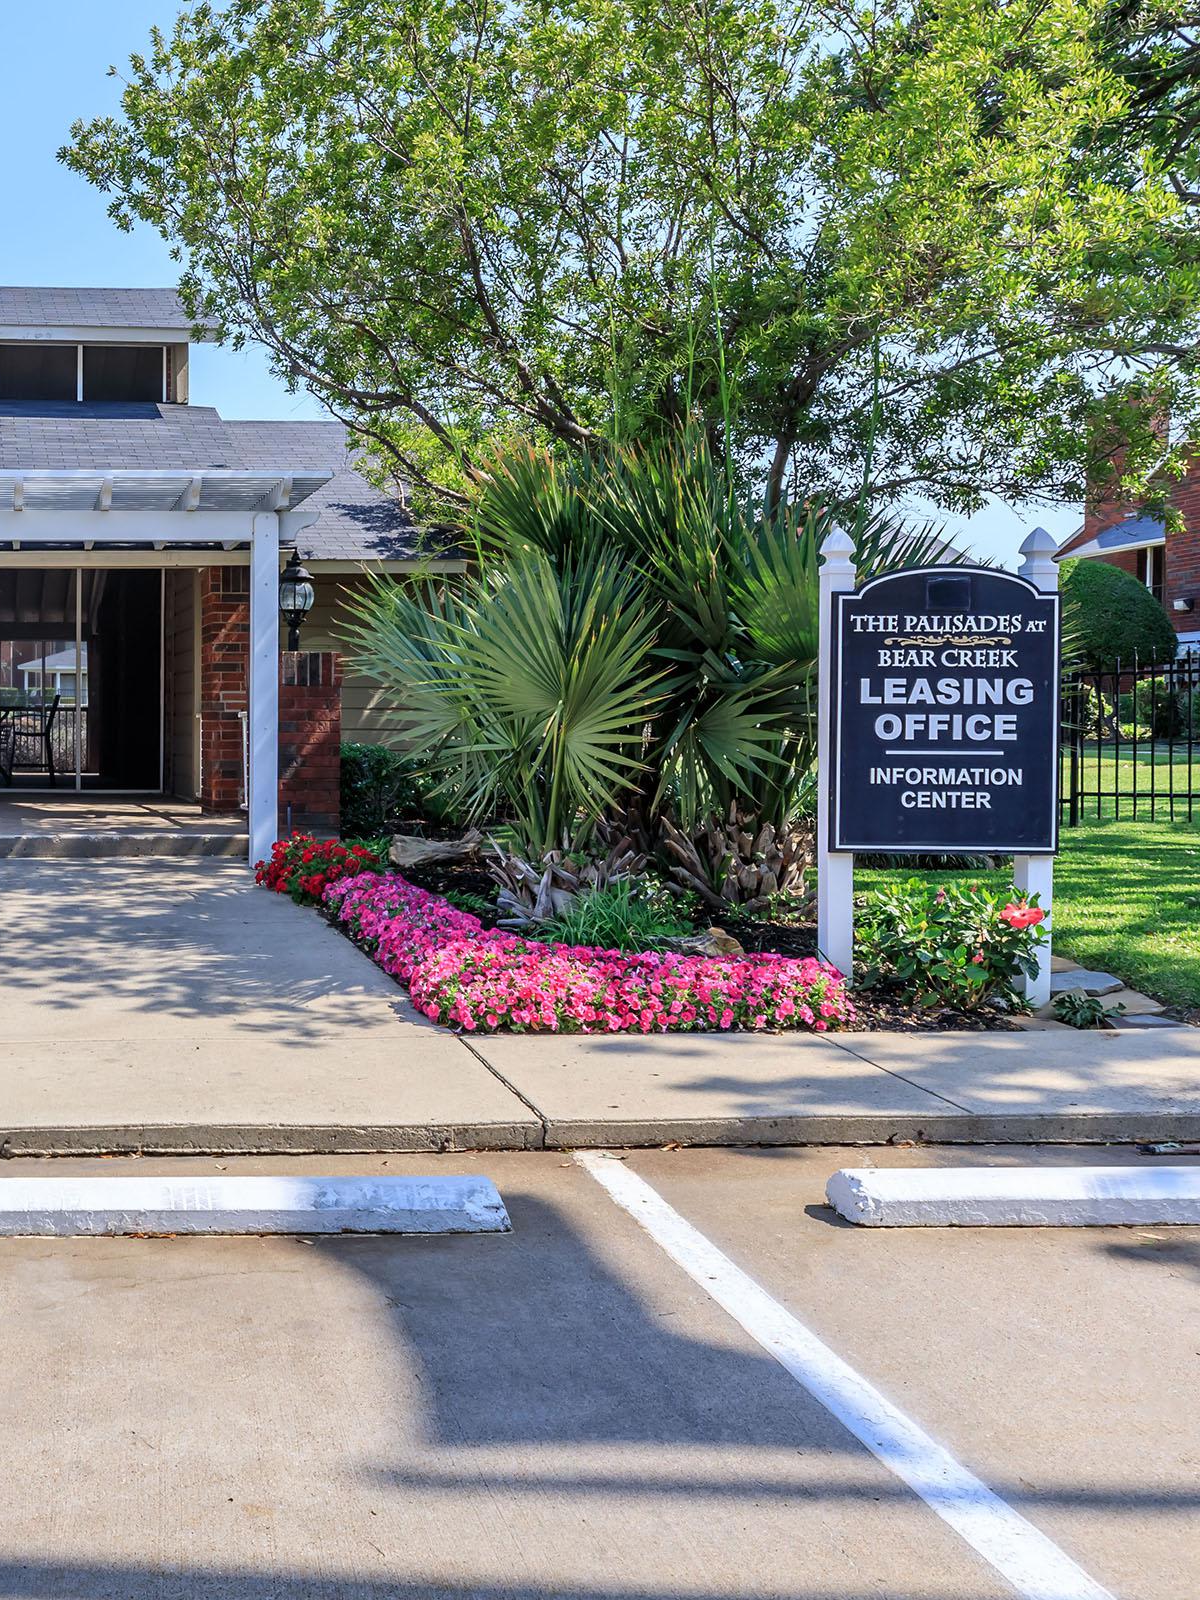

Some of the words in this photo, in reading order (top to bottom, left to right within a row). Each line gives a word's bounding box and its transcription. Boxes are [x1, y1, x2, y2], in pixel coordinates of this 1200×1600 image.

[850, 614, 897, 633] THE
[903, 614, 1022, 633] PALISADES
[1025, 620, 1046, 632] AT
[877, 649, 937, 668] BEAR
[940, 649, 1018, 668] CREEK
[860, 678, 1034, 705] LEASING
[874, 713, 1018, 740] OFFICE
[869, 767, 1023, 785] INFORMATION
[901, 791, 991, 808] CENTER
